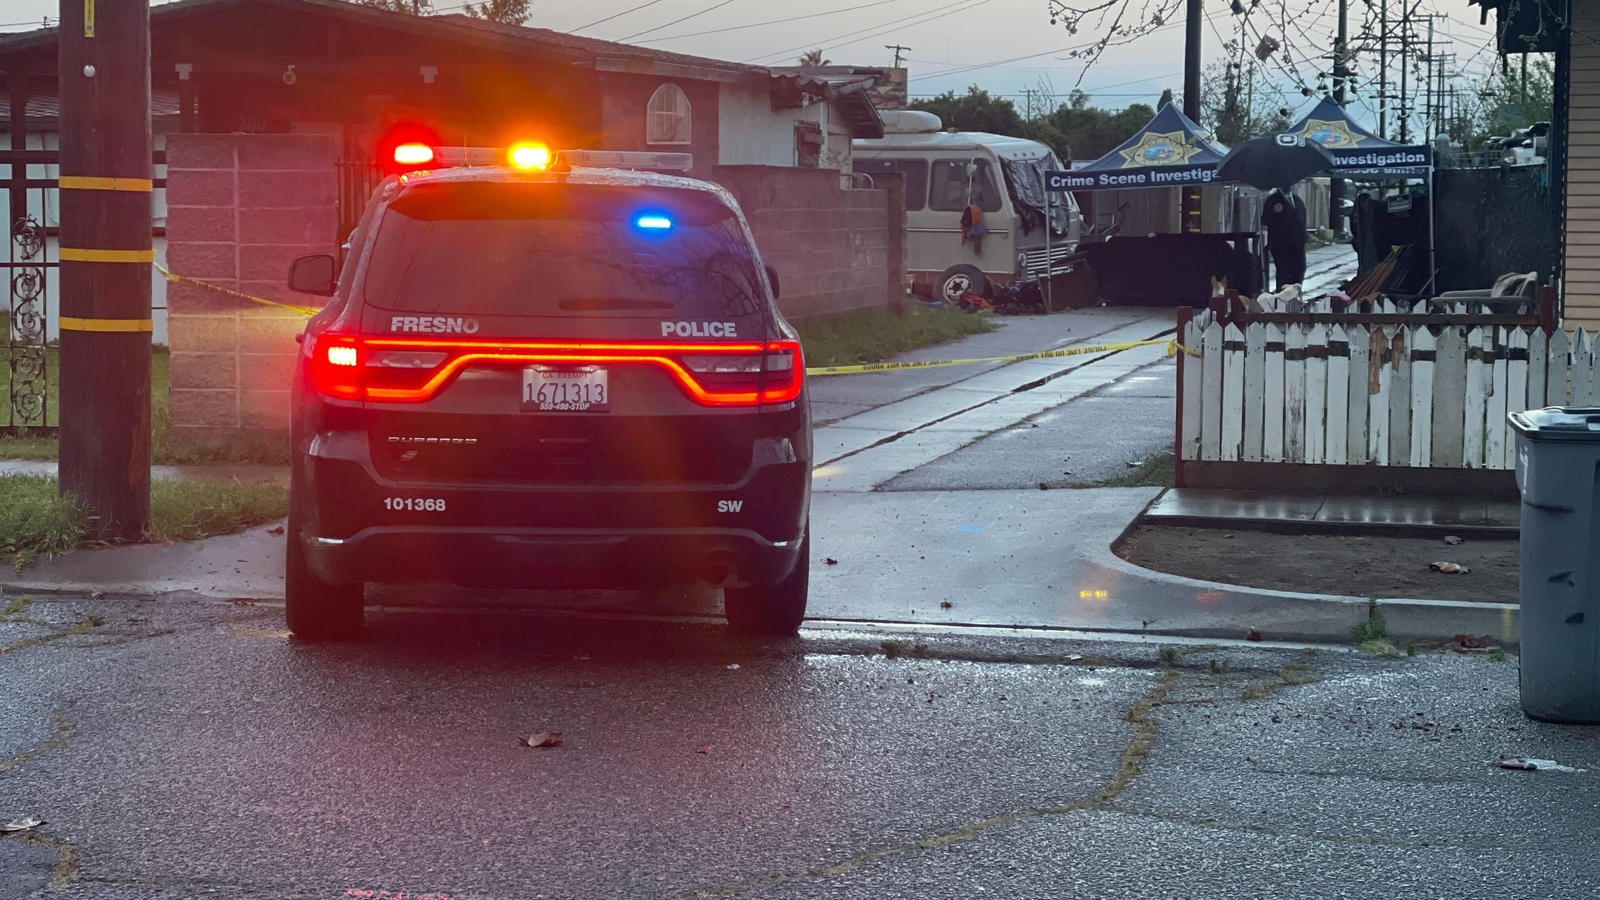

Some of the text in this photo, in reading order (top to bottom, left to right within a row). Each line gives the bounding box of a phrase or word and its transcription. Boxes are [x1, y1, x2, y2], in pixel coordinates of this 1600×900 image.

[1050, 176, 1094, 188] Crime
[1099, 173, 1146, 185] Scene
[391, 316, 479, 334] FRESNO
[661, 321, 737, 338] POLICE
[526, 382, 604, 403] 1671313
[539, 402, 590, 410] 559-498-STOP
[384, 497, 446, 512] 101368
[717, 500, 743, 513] SW
